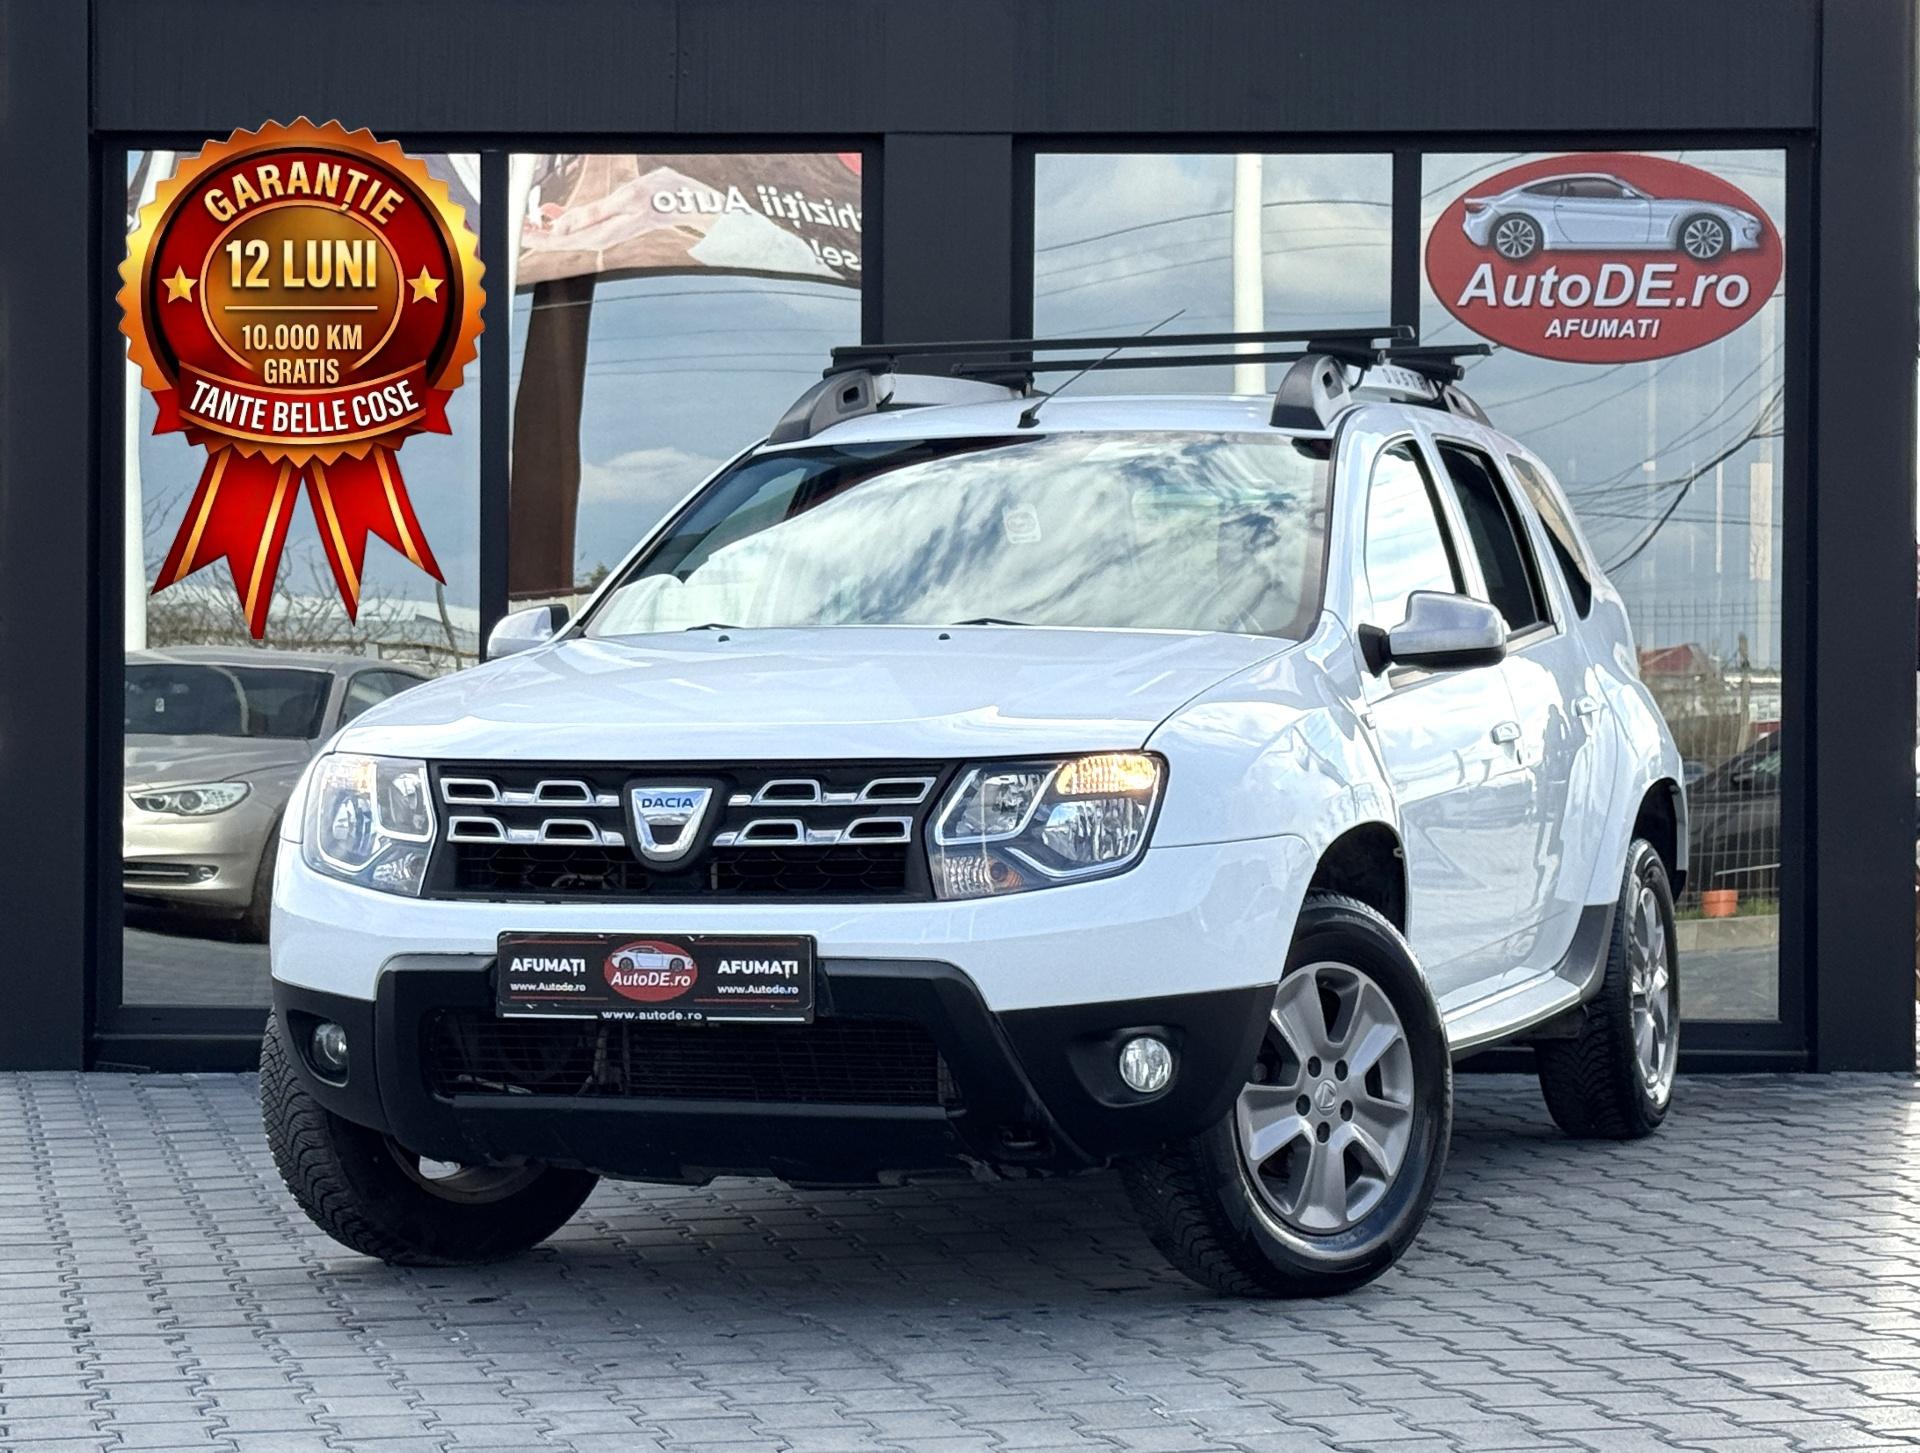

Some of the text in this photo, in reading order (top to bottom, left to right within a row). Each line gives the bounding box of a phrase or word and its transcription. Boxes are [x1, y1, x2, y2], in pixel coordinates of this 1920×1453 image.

[1457, 263, 1749, 308] AutoDE.ro
[1545, 319, 1661, 339] AFUMATI
[642, 797, 694, 808] DACIA
[611, 971, 691, 986] AutoDE.ro
[510, 982, 586, 992] www.Autode.ro
[717, 984, 799, 994] www.Autode.ro
[601, 1010, 702, 1020] www.autode.ro
